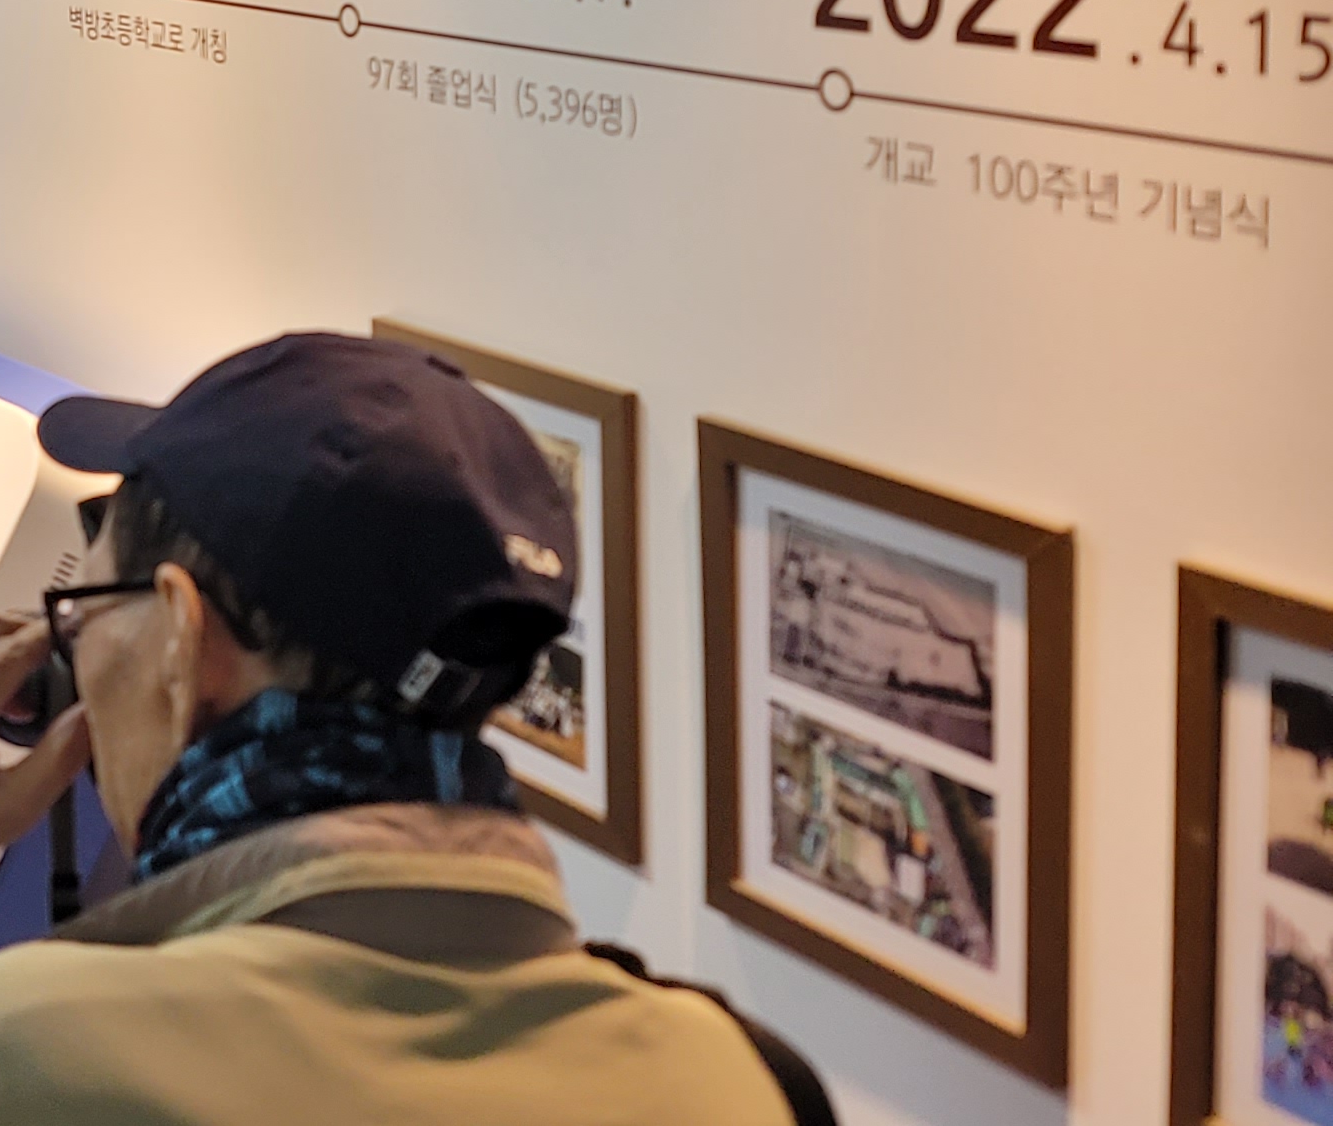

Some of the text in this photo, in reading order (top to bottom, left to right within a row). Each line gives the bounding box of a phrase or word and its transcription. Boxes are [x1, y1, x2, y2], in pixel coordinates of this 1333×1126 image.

[68, 5, 228, 64] 벽방초등학교로 개칭
[367, 55, 639, 139] 97회 졸업식 (5,396명)
[863, 135, 1271, 250] 개교 100주년 기념식
